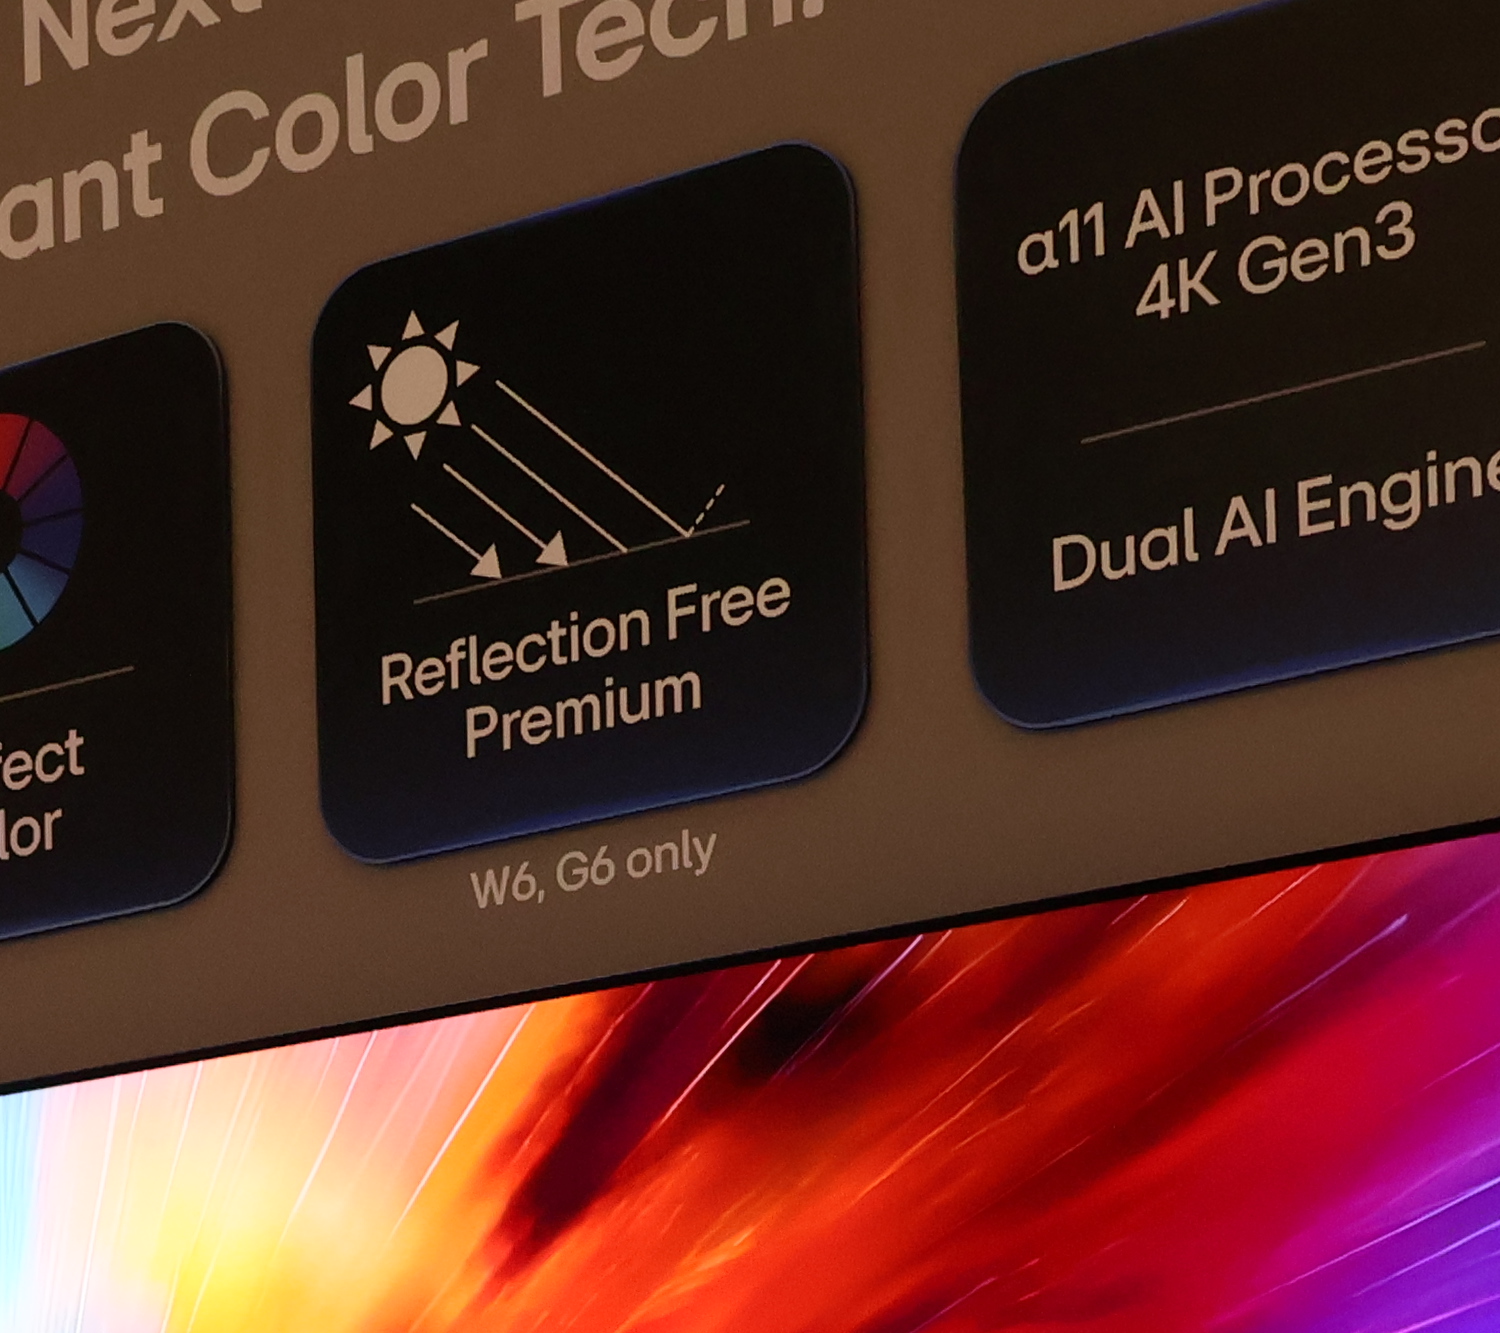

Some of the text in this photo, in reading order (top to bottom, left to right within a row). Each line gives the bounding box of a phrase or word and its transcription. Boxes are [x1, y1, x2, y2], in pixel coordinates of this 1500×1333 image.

[23, 0, 262, 86] Nex
[190, 38, 488, 196] Color
[1125, 180, 1184, 248] AI
[1136, 201, 1415, 319] 4K Gen3
[1053, 507, 1198, 591] Dual
[1215, 488, 1276, 555] AI
[382, 578, 790, 705] Reflection Free
[467, 672, 700, 758] Premium
[471, 829, 716, 908] W6, G6 only
